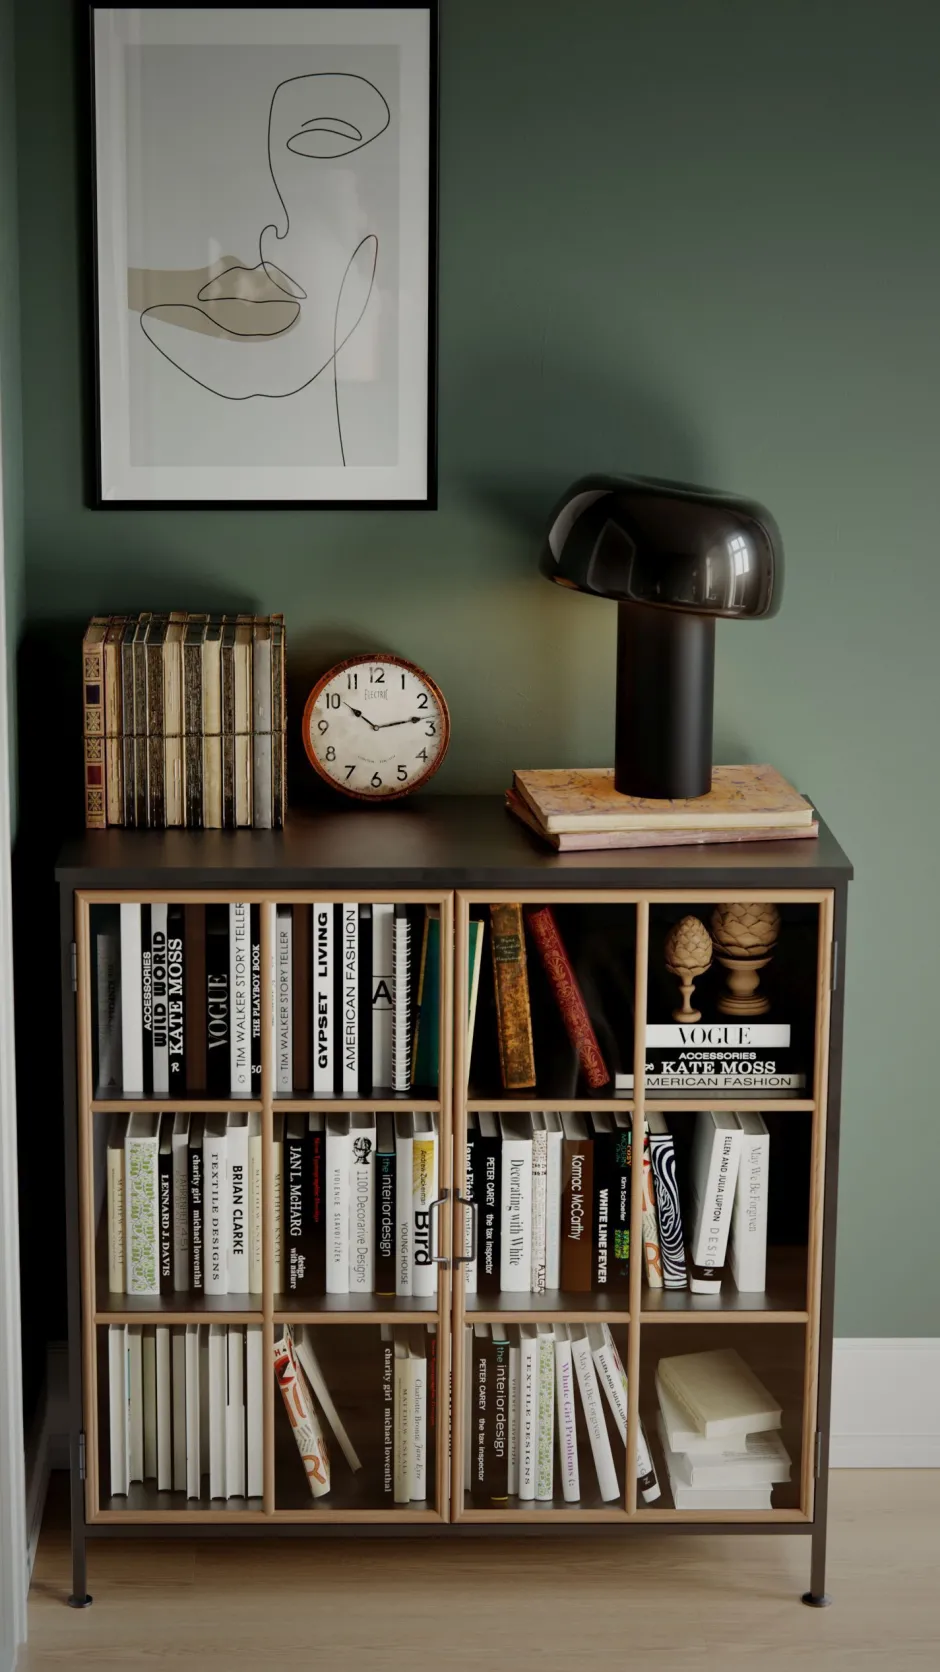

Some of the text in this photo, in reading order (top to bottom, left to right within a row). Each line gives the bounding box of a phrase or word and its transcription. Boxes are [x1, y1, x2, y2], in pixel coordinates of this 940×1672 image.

[347, 674, 358, 690] 11
[369, 667, 385, 684] 12
[401, 674, 405, 690] 1
[326, 693, 341, 709] 10
[364, 689, 388, 700] ELECTRIC
[416, 693, 428, 709] 2
[317, 720, 329, 736] 9
[425, 721, 436, 737] 3
[325, 746, 336, 762] 8
[415, 747, 428, 762] 4
[344, 766, 356, 780] 7
[370, 772, 382, 788] 6
[396, 765, 408, 781] 5
[143, 952, 152, 1031] ACCESSORIES
[153, 931, 167, 1047] WILD WORLD
[168, 938, 184, 1055] KATE MOSS
[235, 902, 246, 1068] TIM WALKER STORY TELLER
[252, 944, 260, 1038] THE PLAYBOY BOOK
[318, 912, 328, 1069] GYPSET LIVING
[346, 910, 356, 1071] AMERICAN FASHION
[372, 980, 393, 1004] A
[208, 974, 228, 1049] VOGUE
[280, 931, 288, 1072] TIM WALKER STORY TELLER
[679, 1027, 751, 1045] VOGUE
[252, 1065, 262, 1074] 50
[661, 1061, 776, 1074] KATE MOSS
[679, 1052, 757, 1060] ACCESSORIES
[646, 1078, 792, 1086] MERICAN FASHION
[191, 1154, 200, 1204] charity girl
[290, 1172, 301, 1182] L.
[356, 1170, 368, 1193] 1100
[486, 1156, 494, 1181] PETER
[712, 1136, 732, 1222] ELLEN AND JULIA LUPTON
[486, 1182, 494, 1207] CAREY
[568, 1155, 585, 1240] Kormac McCarthy
[746, 1146, 762, 1232] May We Be Forgiven
[161, 1174, 170, 1276] LENNARD J. DAVIS
[232, 1166, 243, 1255] BRIAN CLARKE
[290, 1184, 302, 1237] McHARG
[486, 1214, 494, 1227] the
[506, 1160, 524, 1266] Decorating with White
[212, 1218, 220, 1280] DESIGNS
[400, 1222, 408, 1252] YOUNG
[414, 1211, 432, 1266] Bird
[598, 1188, 608, 1284] WHITE LINE FEVER
[194, 1247, 202, 1288] lowenthal
[298, 1255, 306, 1278] design
[354, 1248, 368, 1284] Designs
[485, 1242, 494, 1275] inspector
[704, 1228, 720, 1276] DESIGN
[496, 1347, 504, 1362] the
[414, 1378, 423, 1414] Charlotte
[578, 1352, 600, 1440] May We Be Forgiven
[599, 1354, 628, 1430] ELLEN AND JULIA LUPTO
[382, 1348, 392, 1492] charity girl michael lowenthal
[564, 1402, 572, 1424] Girl
[414, 1442, 423, 1461] Jane
[478, 1446, 486, 1482] inspector
[566, 1426, 575, 1476] Problems
[637, 1456, 650, 1485] SIGN
